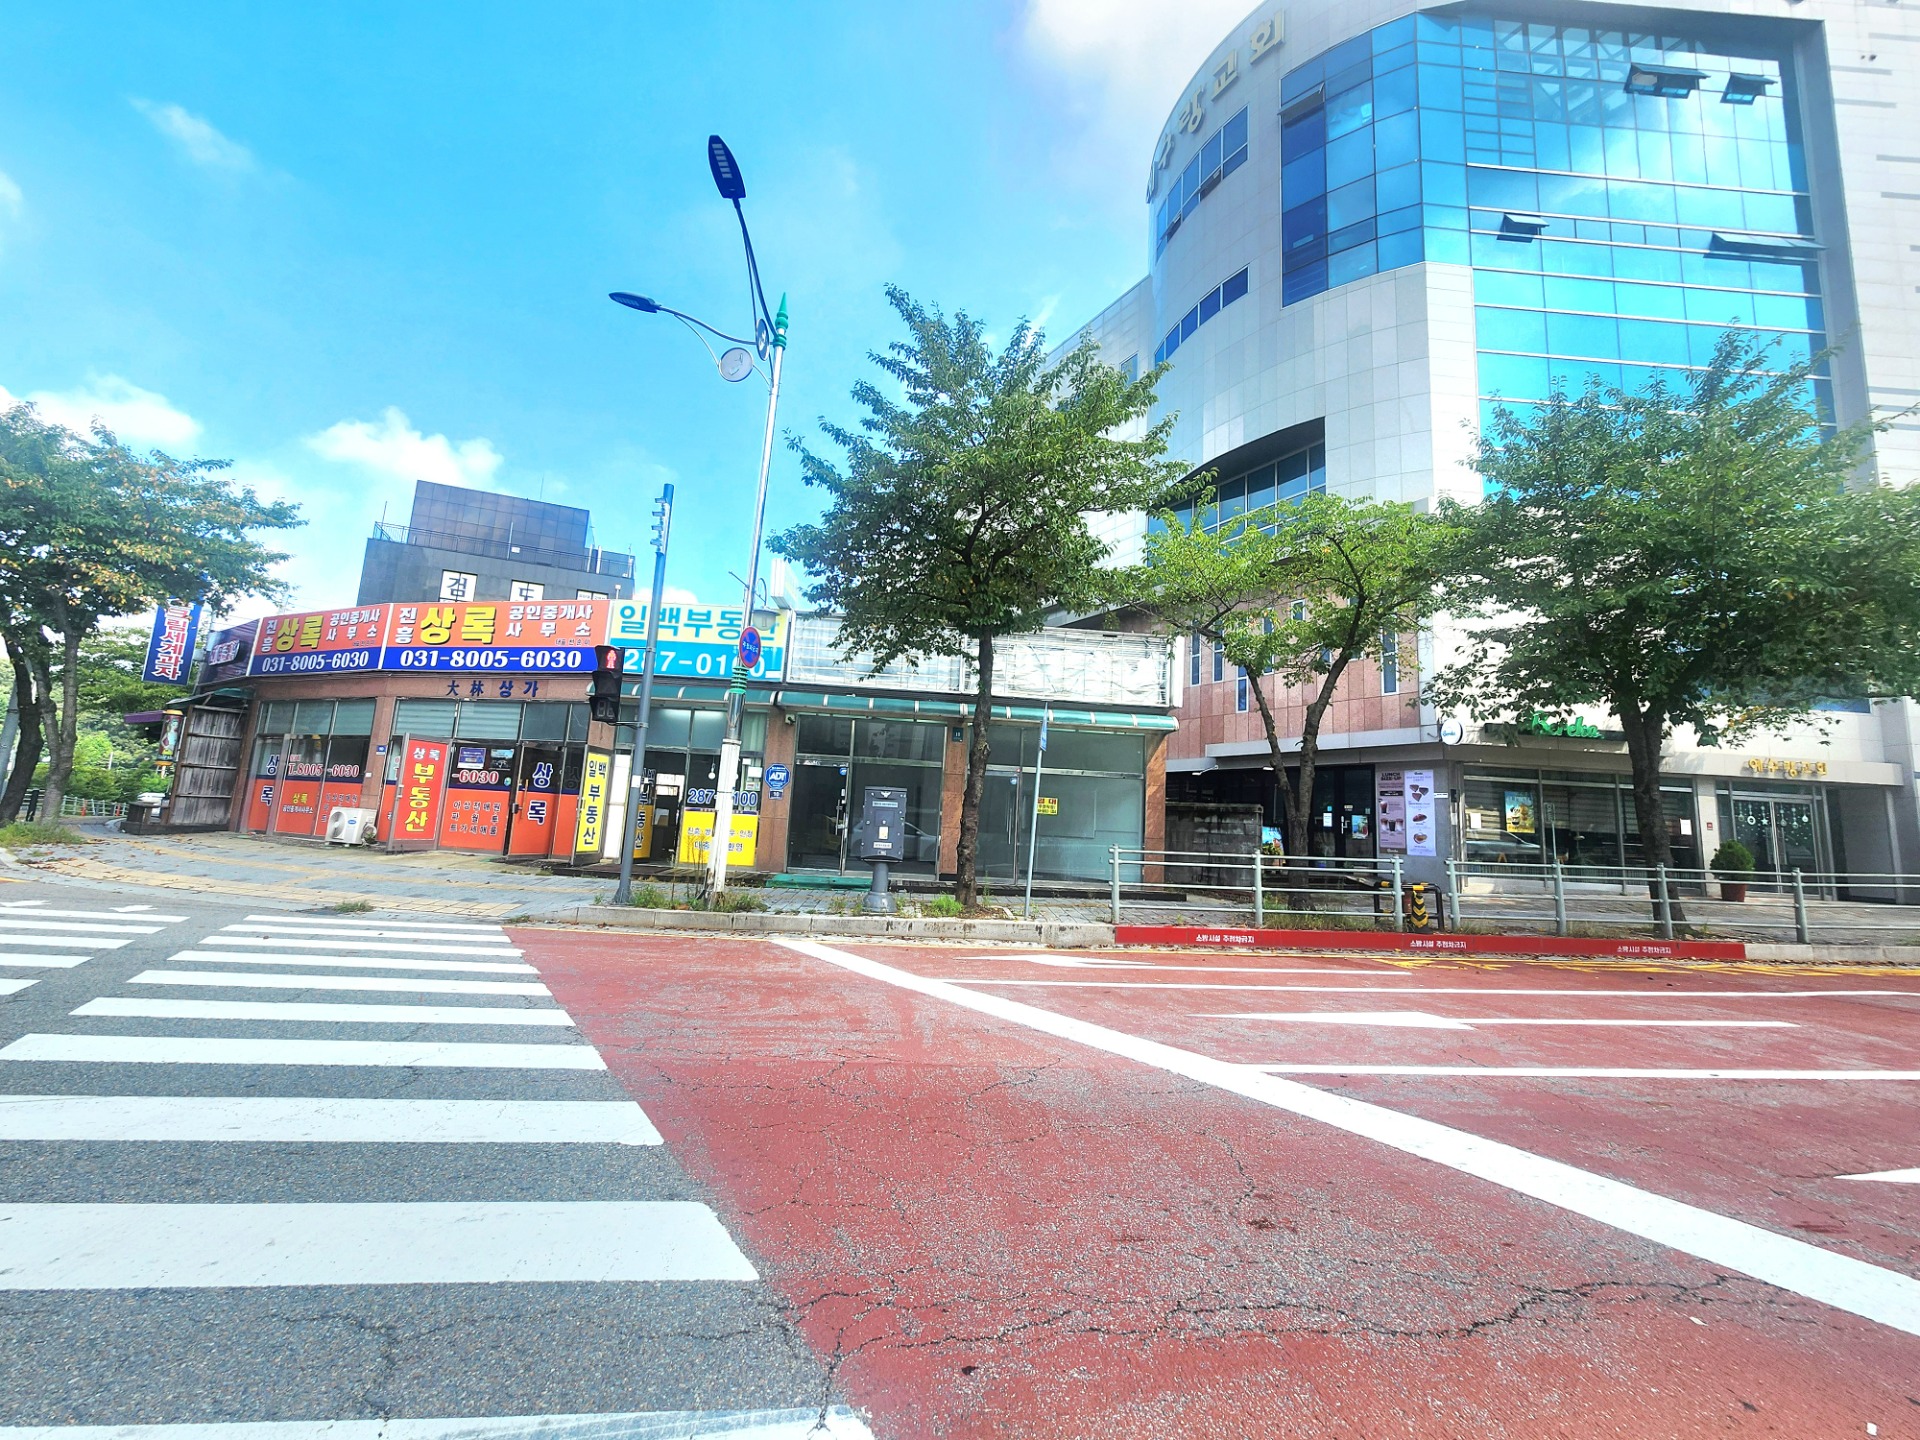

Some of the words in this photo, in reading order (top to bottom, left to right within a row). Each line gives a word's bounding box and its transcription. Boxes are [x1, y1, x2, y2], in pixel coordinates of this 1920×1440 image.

[447, 577, 468, 598] 검
[276, 615, 324, 652] 상록
[330, 608, 381, 627] 공인중개사
[395, 607, 417, 644] 진흥
[420, 606, 497, 645] 상록
[509, 605, 593, 621] 공인중개사
[262, 651, 369, 672] 031-8005-6030
[400, 649, 582, 669] 031-8005-6030
[768, 771, 787, 781] ADT
[405, 762, 435, 832] 부동산
[583, 784, 601, 846] 부동산
